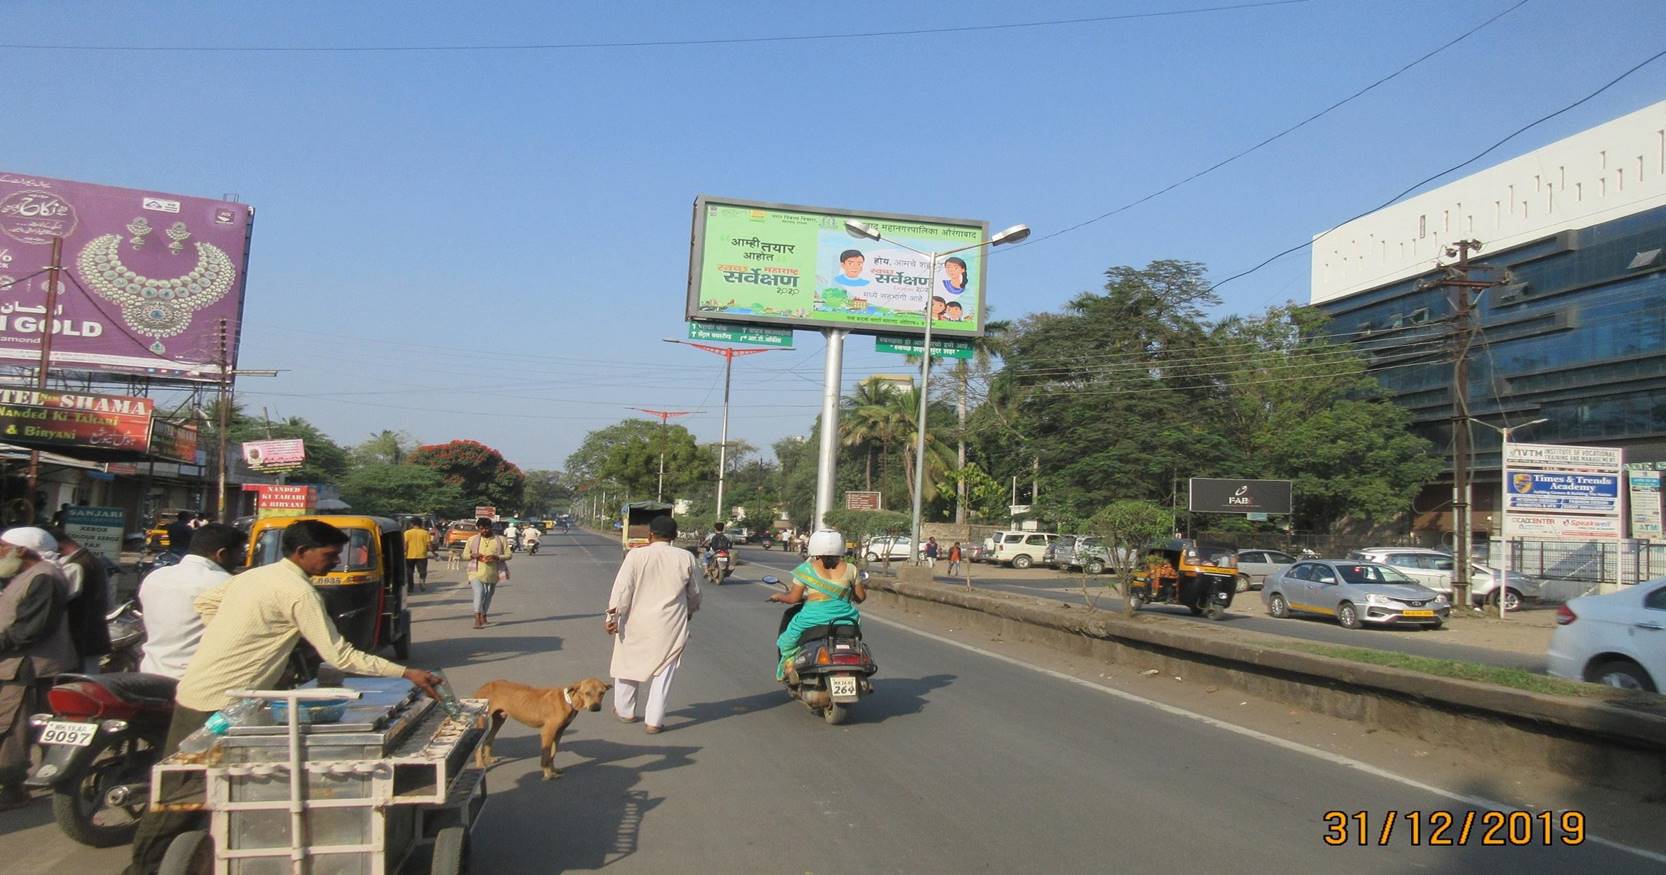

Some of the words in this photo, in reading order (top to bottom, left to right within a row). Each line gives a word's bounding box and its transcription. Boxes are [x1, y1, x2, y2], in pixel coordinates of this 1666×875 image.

[731, 237, 761, 249] आम्ही
[761, 242, 796, 254] तयार
[743, 251, 774, 261] आहोत
[723, 268, 800, 287] सर्वेक्षण
[14, 316, 103, 337] GOLD
[60, 394, 146, 416] SHAMA
[6, 424, 17, 435] &
[1534, 475, 1562, 483] Times
[1576, 476, 1612, 484] Trends
[1550, 483, 1596, 491] Academy
[44, 730, 92, 744] 9097
